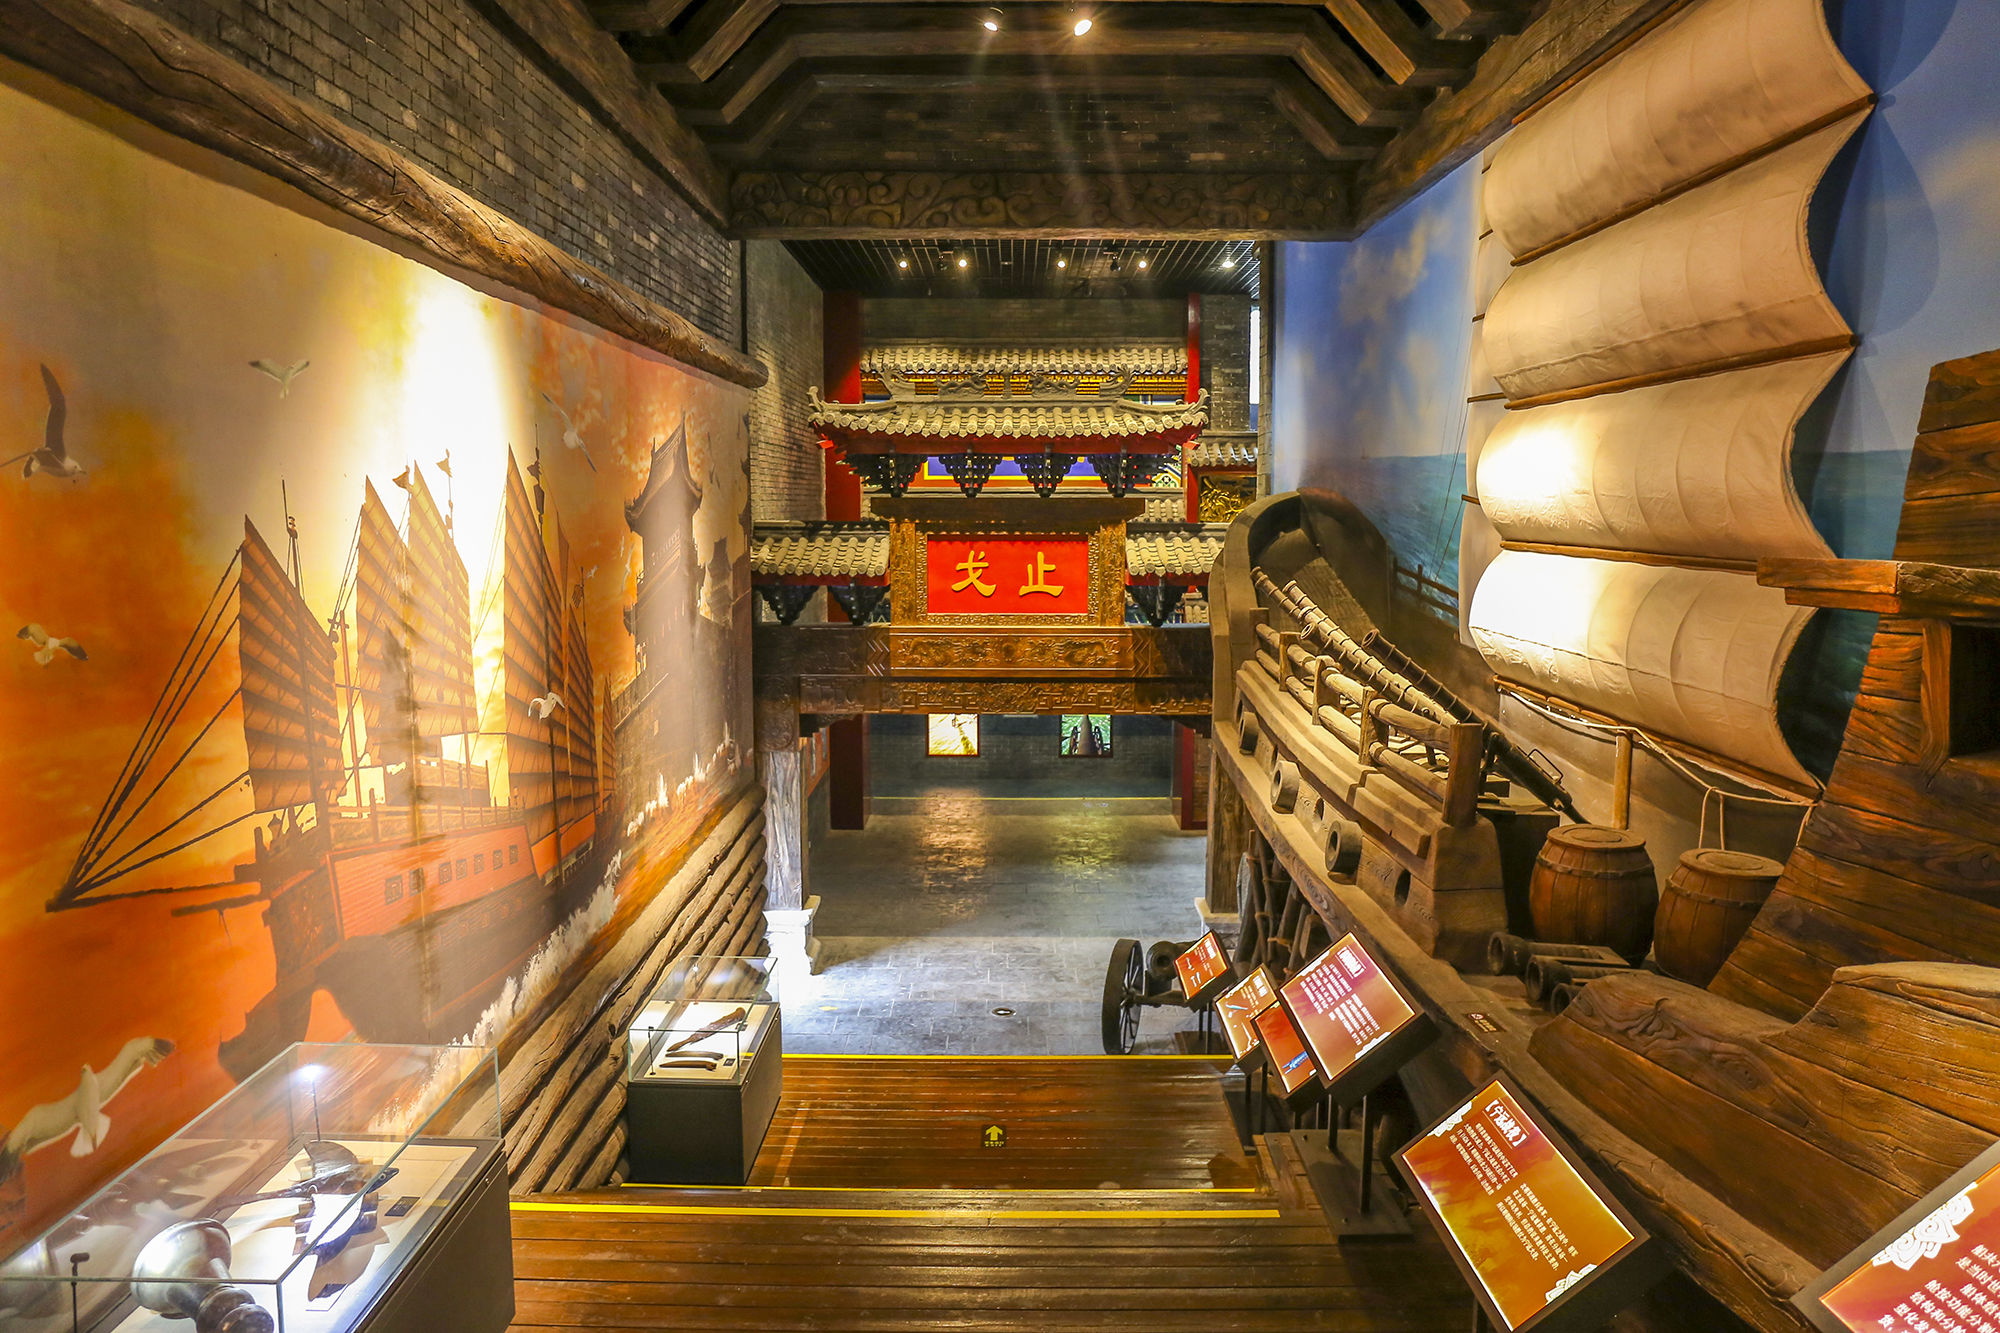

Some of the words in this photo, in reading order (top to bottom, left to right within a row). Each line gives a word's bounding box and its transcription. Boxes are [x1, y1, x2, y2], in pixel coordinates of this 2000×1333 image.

[1955, 1257, 2000, 1298] 是当时世
[1893, 1303, 1940, 1333] 型化发
